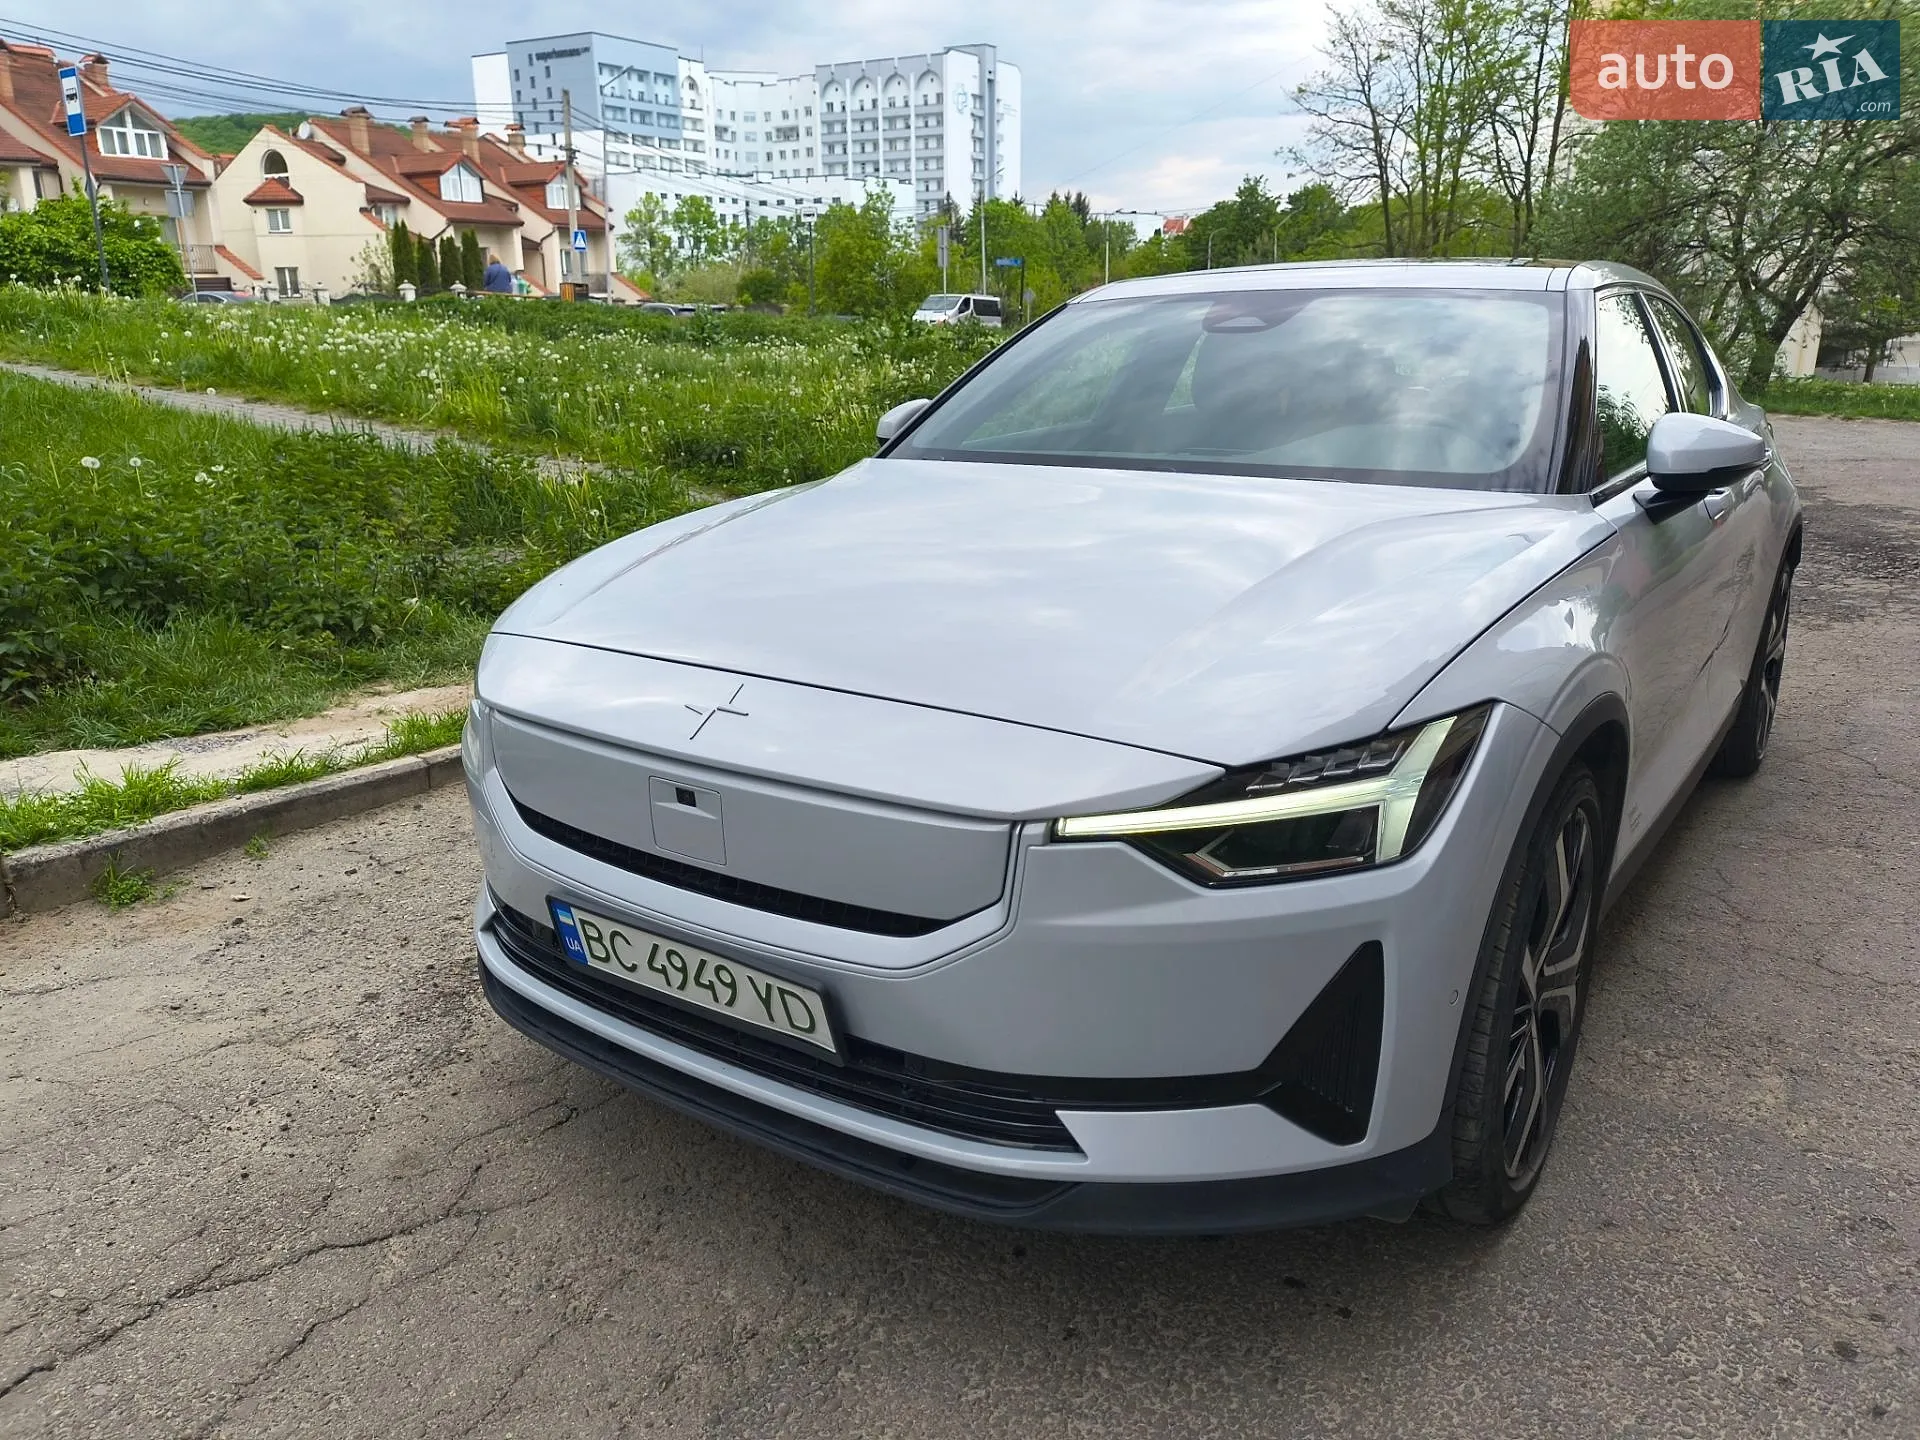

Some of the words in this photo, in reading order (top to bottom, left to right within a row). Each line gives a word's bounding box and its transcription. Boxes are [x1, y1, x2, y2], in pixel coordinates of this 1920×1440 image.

[565, 935, 583, 953] UA
[578, 917, 638, 973] BC
[647, 943, 738, 1008] 4949
[747, 975, 816, 1035] YD
